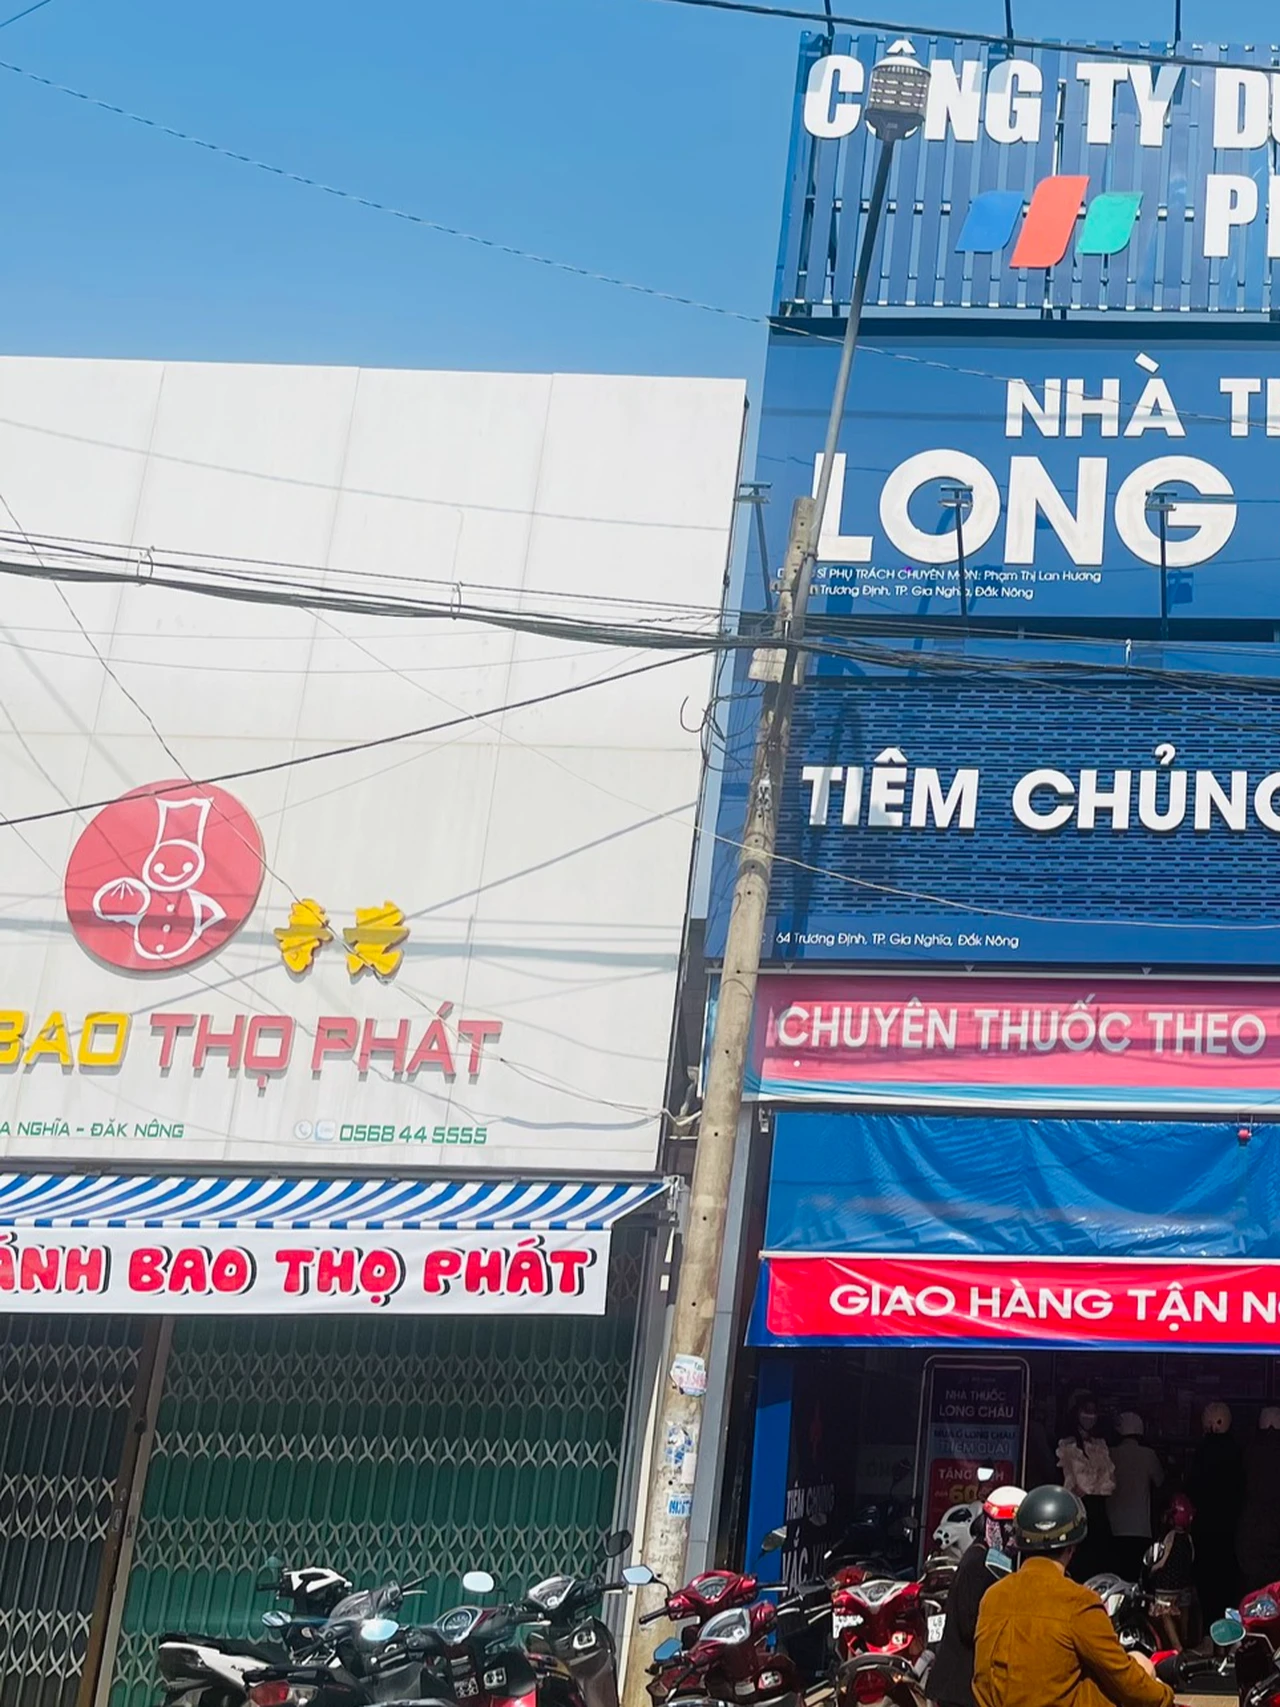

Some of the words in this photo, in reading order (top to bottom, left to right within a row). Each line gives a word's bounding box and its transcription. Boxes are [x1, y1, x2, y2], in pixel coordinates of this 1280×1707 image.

[1076, 62, 1184, 147] TY
[1005, 353, 1186, 438] NHÀ
[813, 448, 1238, 570] LONG
[820, 585, 859, 598] Trương
[1001, 586, 1034, 600] Nông
[829, 568, 853, 581] PHỤ
[855, 566, 896, 580] TRÁCH
[897, 566, 946, 581] CHUYÊN
[984, 569, 1018, 583] Phạm
[1021, 569, 1036, 583] Thị
[1038, 570, 1060, 582] Lan
[1062, 570, 1101, 584] Hương
[802, 747, 980, 830] TIÊM
[776, 933, 790, 944] 64
[794, 933, 834, 946] Trương
[838, 932, 867, 946] Định,
[889, 933, 911, 945] Gia
[985, 933, 1019, 949] Nông
[150, 1012, 294, 1090] THỌ
[311, 1002, 502, 1076] PHÁT
[777, 996, 957, 1051] CHUYÊN
[974, 993, 1132, 1053] THUỐC
[1149, 1012, 1266, 1055] THEO
[17, 1117, 70, 1137] NGHĨA
[90, 1117, 128, 1138] ĐĂK
[134, 1118, 184, 1139] NÔNG
[339, 1124, 394, 1143] 0568
[399, 1124, 427, 1144] 44
[431, 1125, 488, 1145] 5555
[128, 1247, 252, 1294] BAO
[275, 1249, 400, 1306] THỌ
[423, 1238, 590, 1297] PHÁT
[828, 1283, 956, 1319] GIAO
[969, 1269, 1113, 1322] HÀNG
[1127, 1279, 1229, 1332] TẬN
[939, 1404, 975, 1417] LONG
[978, 1402, 1014, 1418] CHÂU
